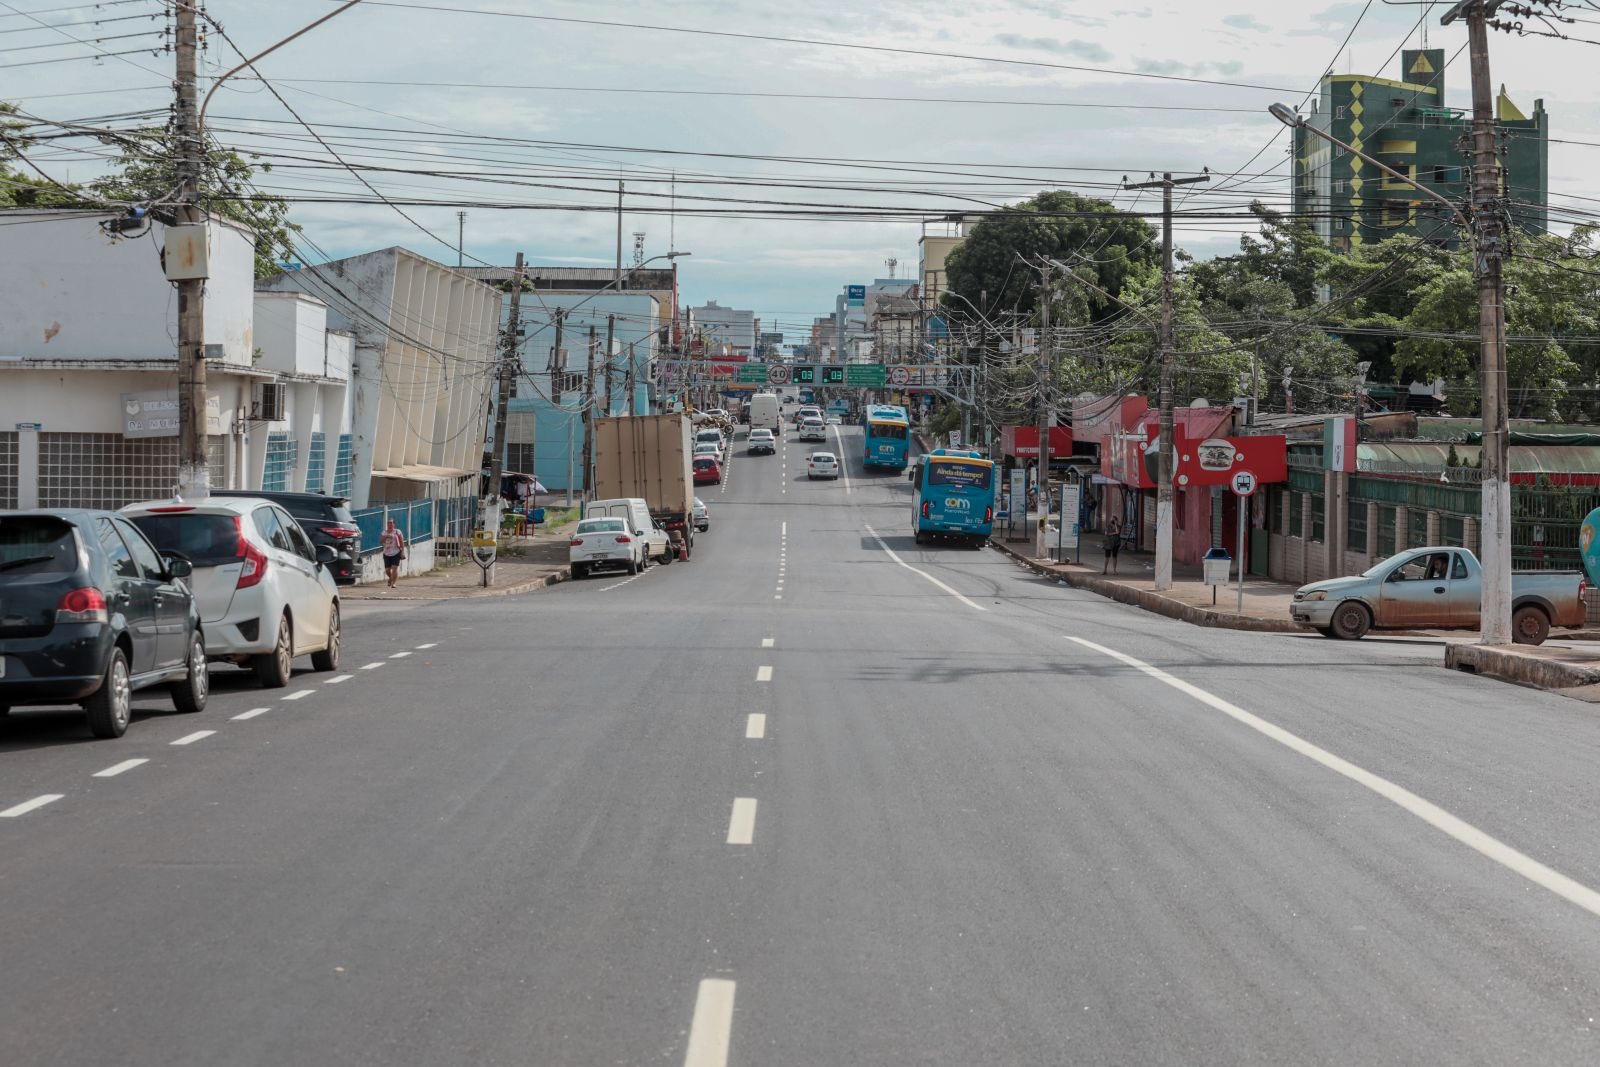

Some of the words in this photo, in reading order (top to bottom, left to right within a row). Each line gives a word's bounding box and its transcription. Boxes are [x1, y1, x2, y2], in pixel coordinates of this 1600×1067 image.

[771, 370, 786, 378] 40
[801, 370, 813, 380] 03
[831, 371, 842, 380] 03
[937, 466, 954, 476] Ainda
